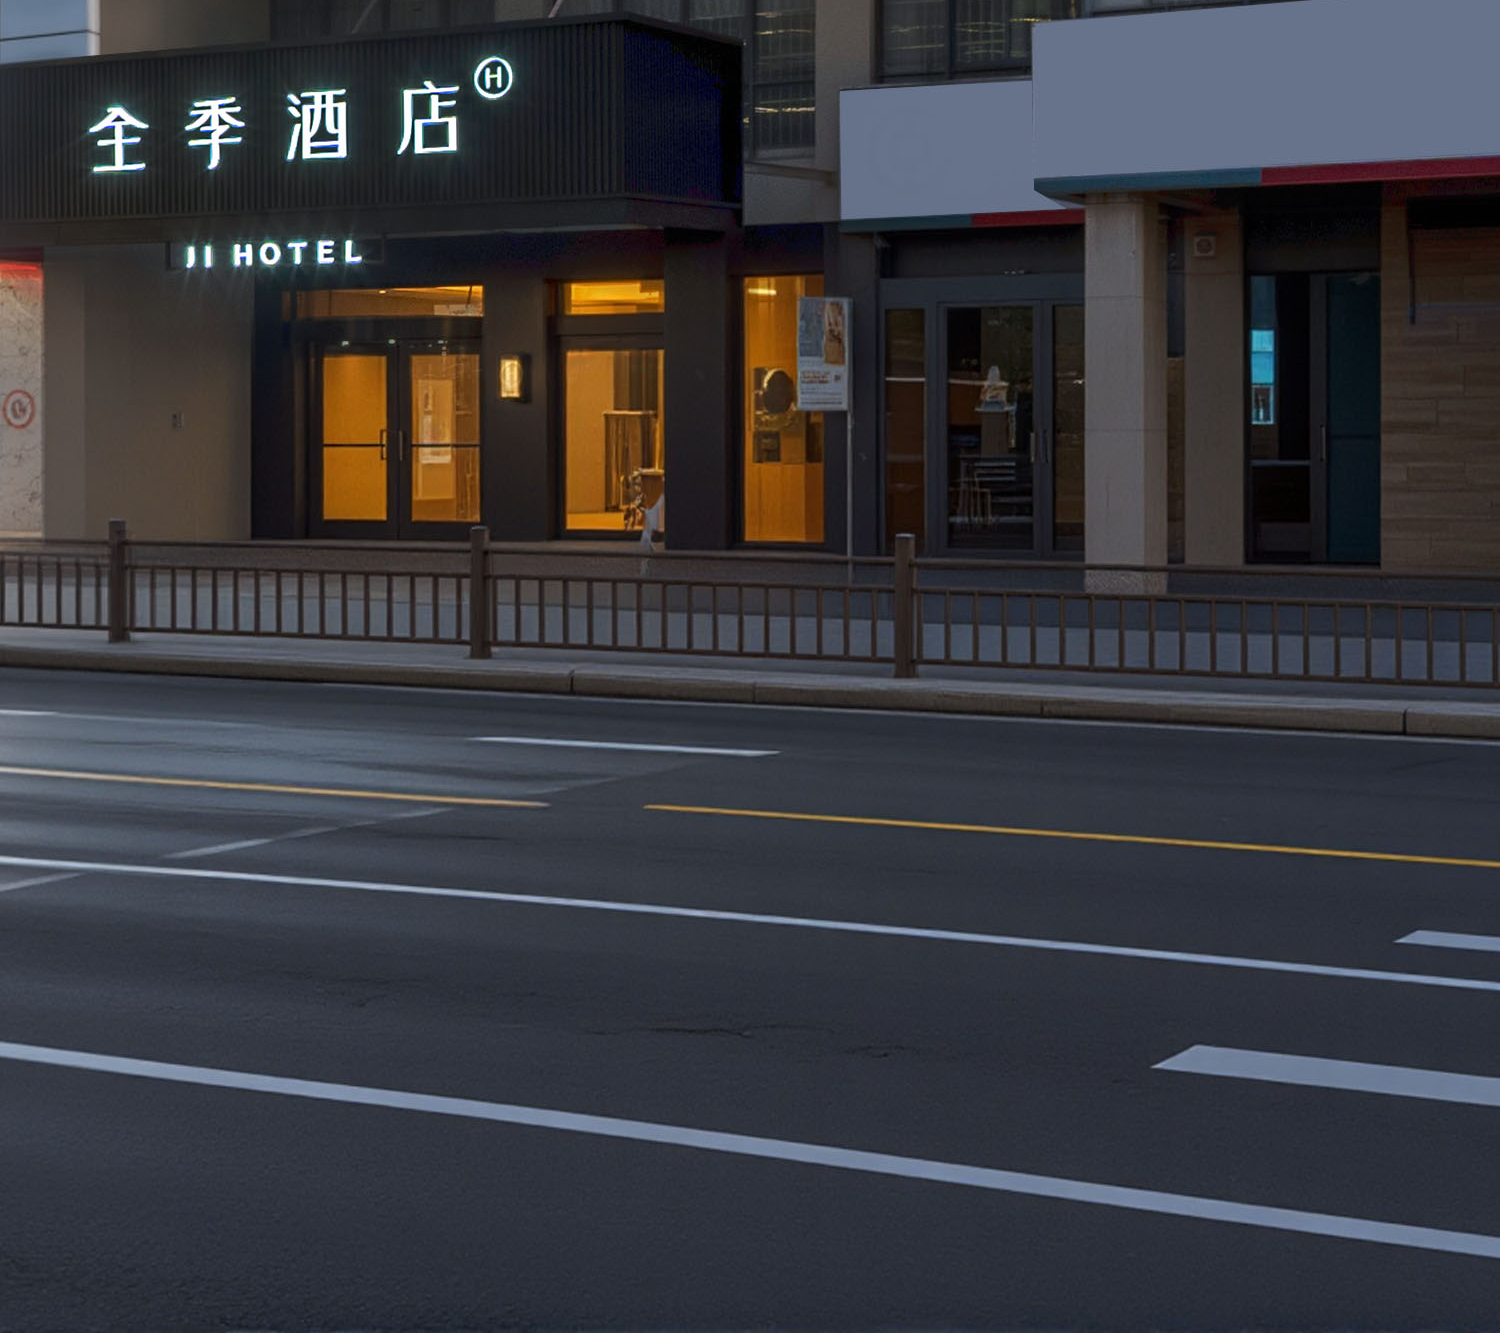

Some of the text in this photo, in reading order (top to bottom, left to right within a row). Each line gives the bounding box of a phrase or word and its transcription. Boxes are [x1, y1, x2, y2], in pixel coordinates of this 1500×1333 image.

[88, 80, 460, 174] 全季酒店
[185, 239, 363, 269] JI HOTEL
